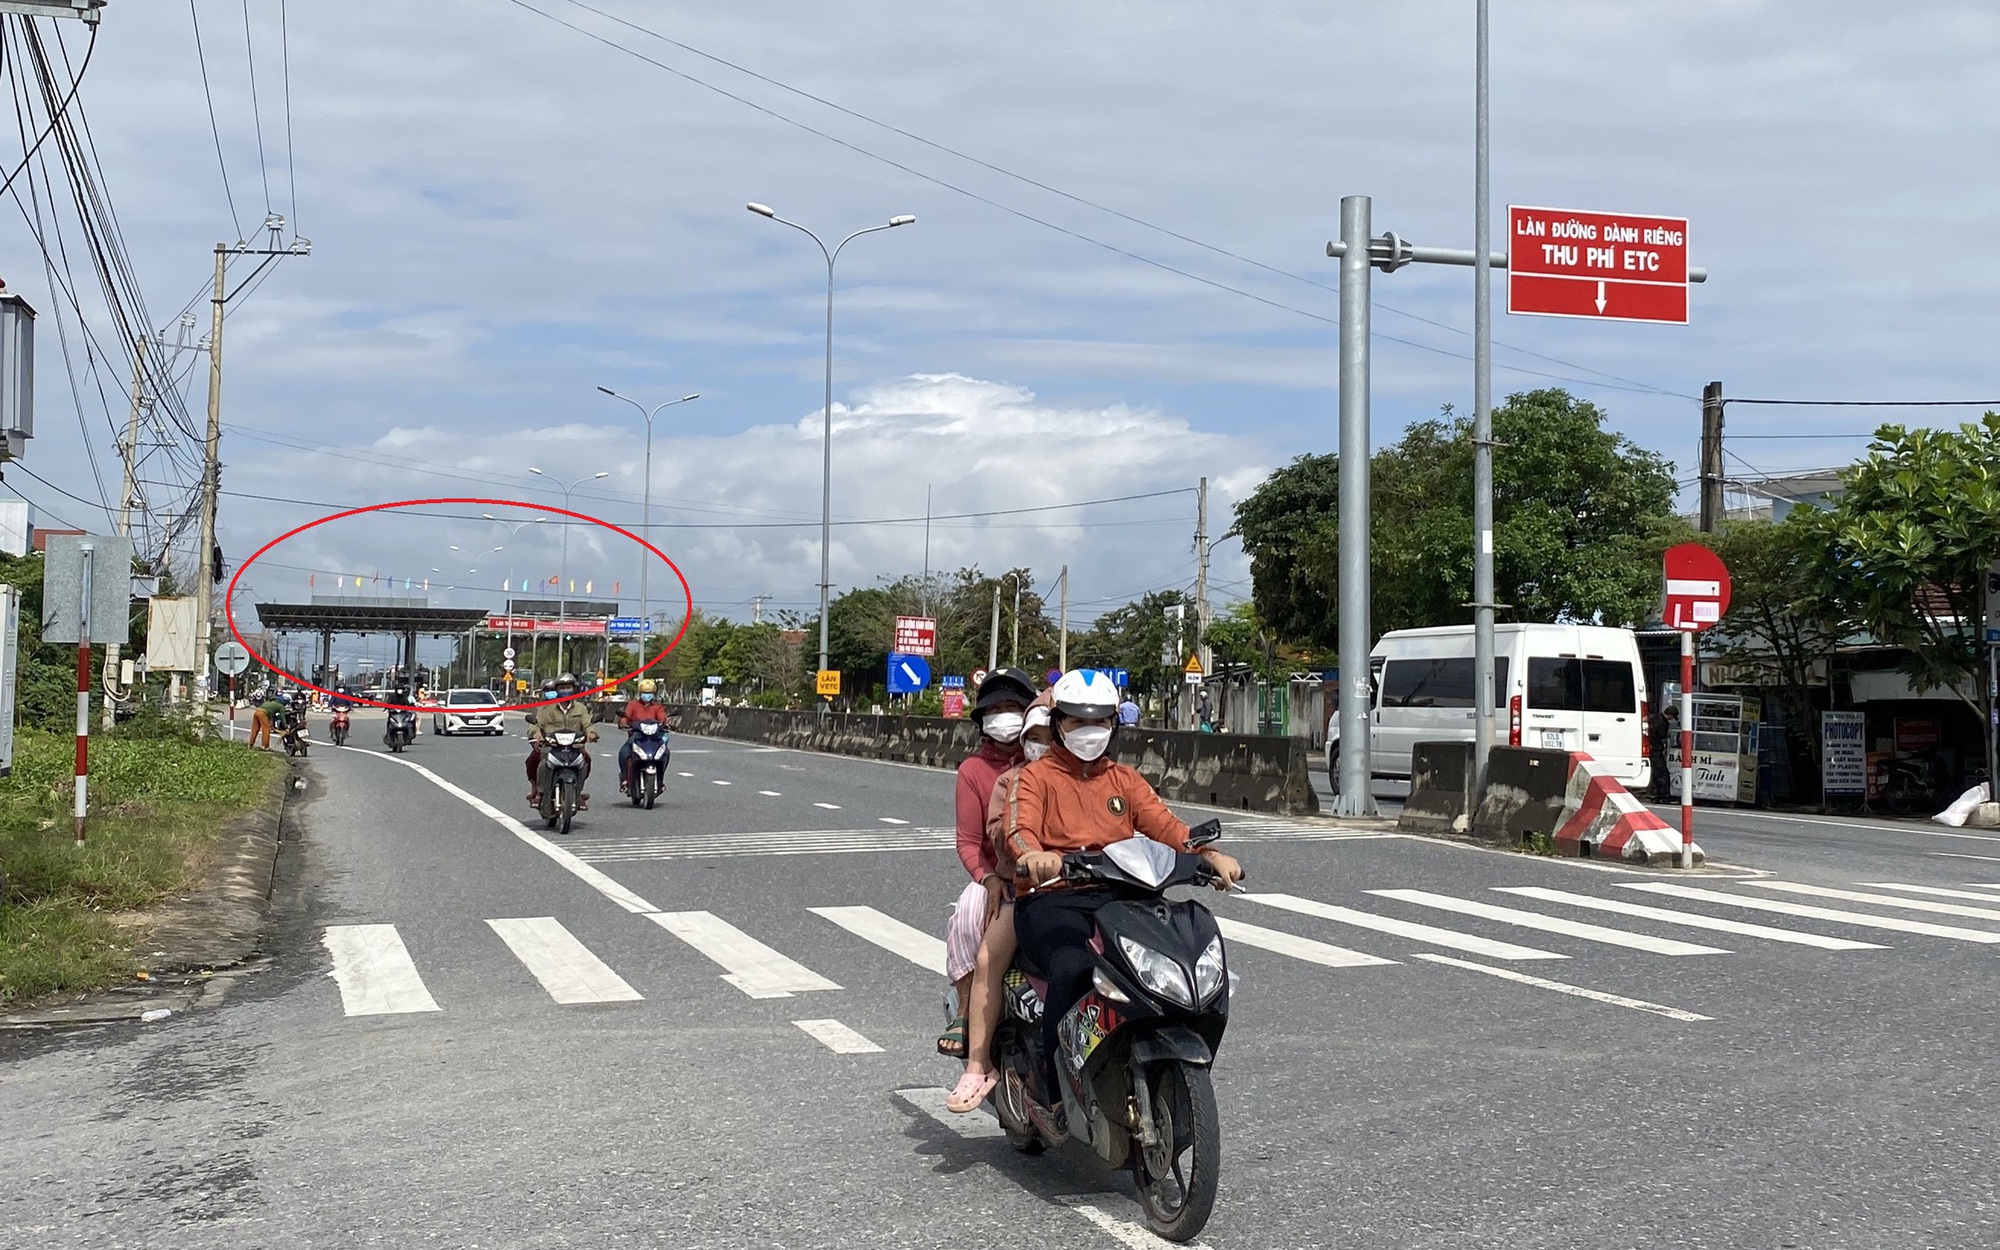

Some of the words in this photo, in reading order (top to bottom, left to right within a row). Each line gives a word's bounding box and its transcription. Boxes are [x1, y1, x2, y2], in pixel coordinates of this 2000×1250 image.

[1517, 216, 1545, 236] LÀN
[1552, 219, 1597, 240] ĐƯỜNG
[1604, 223, 1638, 243] DÀNH
[1643, 226, 1683, 246] RIÊNG
[1542, 244, 1578, 266] THU
[1587, 245, 1615, 269] PHÍ
[1624, 250, 1660, 272] ETC
[1824, 722, 1863, 740] PHOTOCOPY
[1668, 752, 1697, 763] BÁH
[1700, 754, 1712, 765] MÌ
